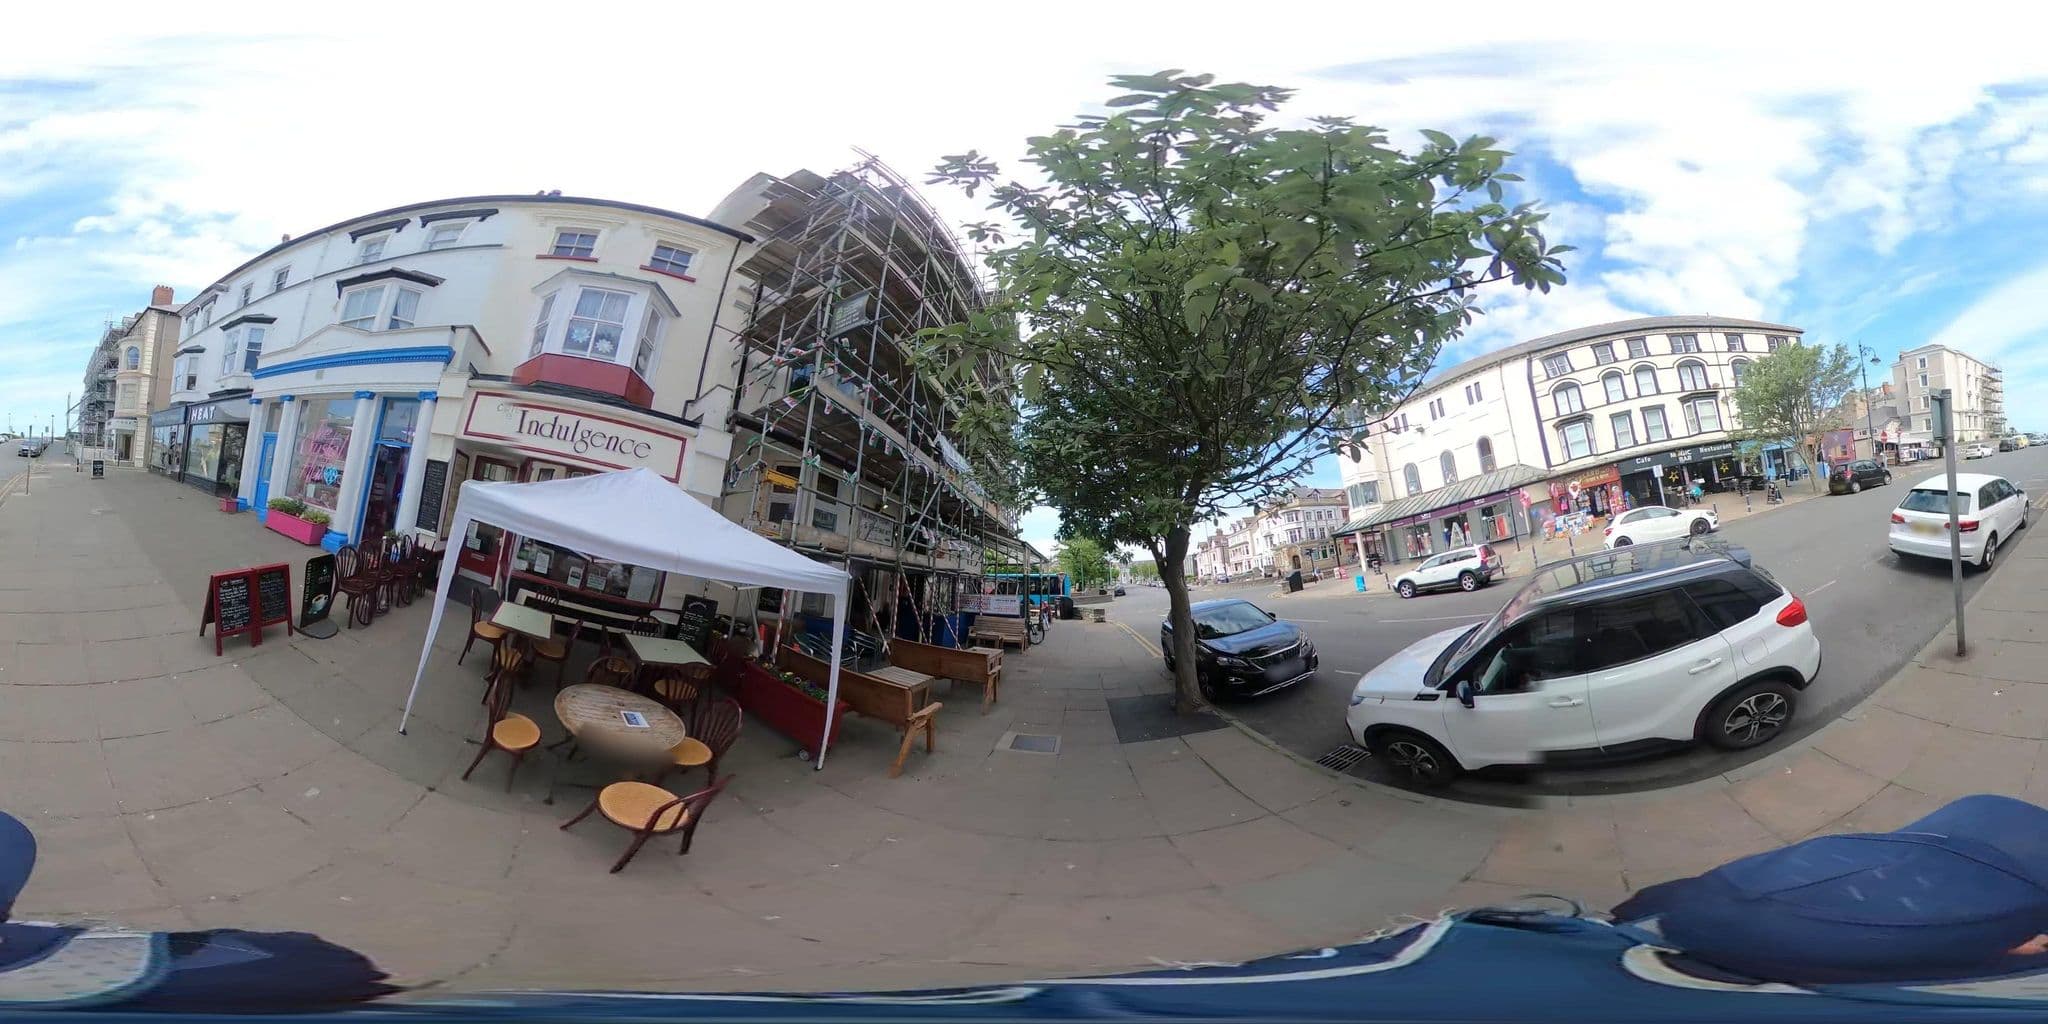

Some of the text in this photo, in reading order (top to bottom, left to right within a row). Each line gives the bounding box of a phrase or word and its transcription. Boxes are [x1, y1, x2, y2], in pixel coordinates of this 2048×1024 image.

[191, 406, 216, 421] HEAT
[516, 409, 652, 459] Indulgence
[1699, 443, 1733, 453] Restaurant
